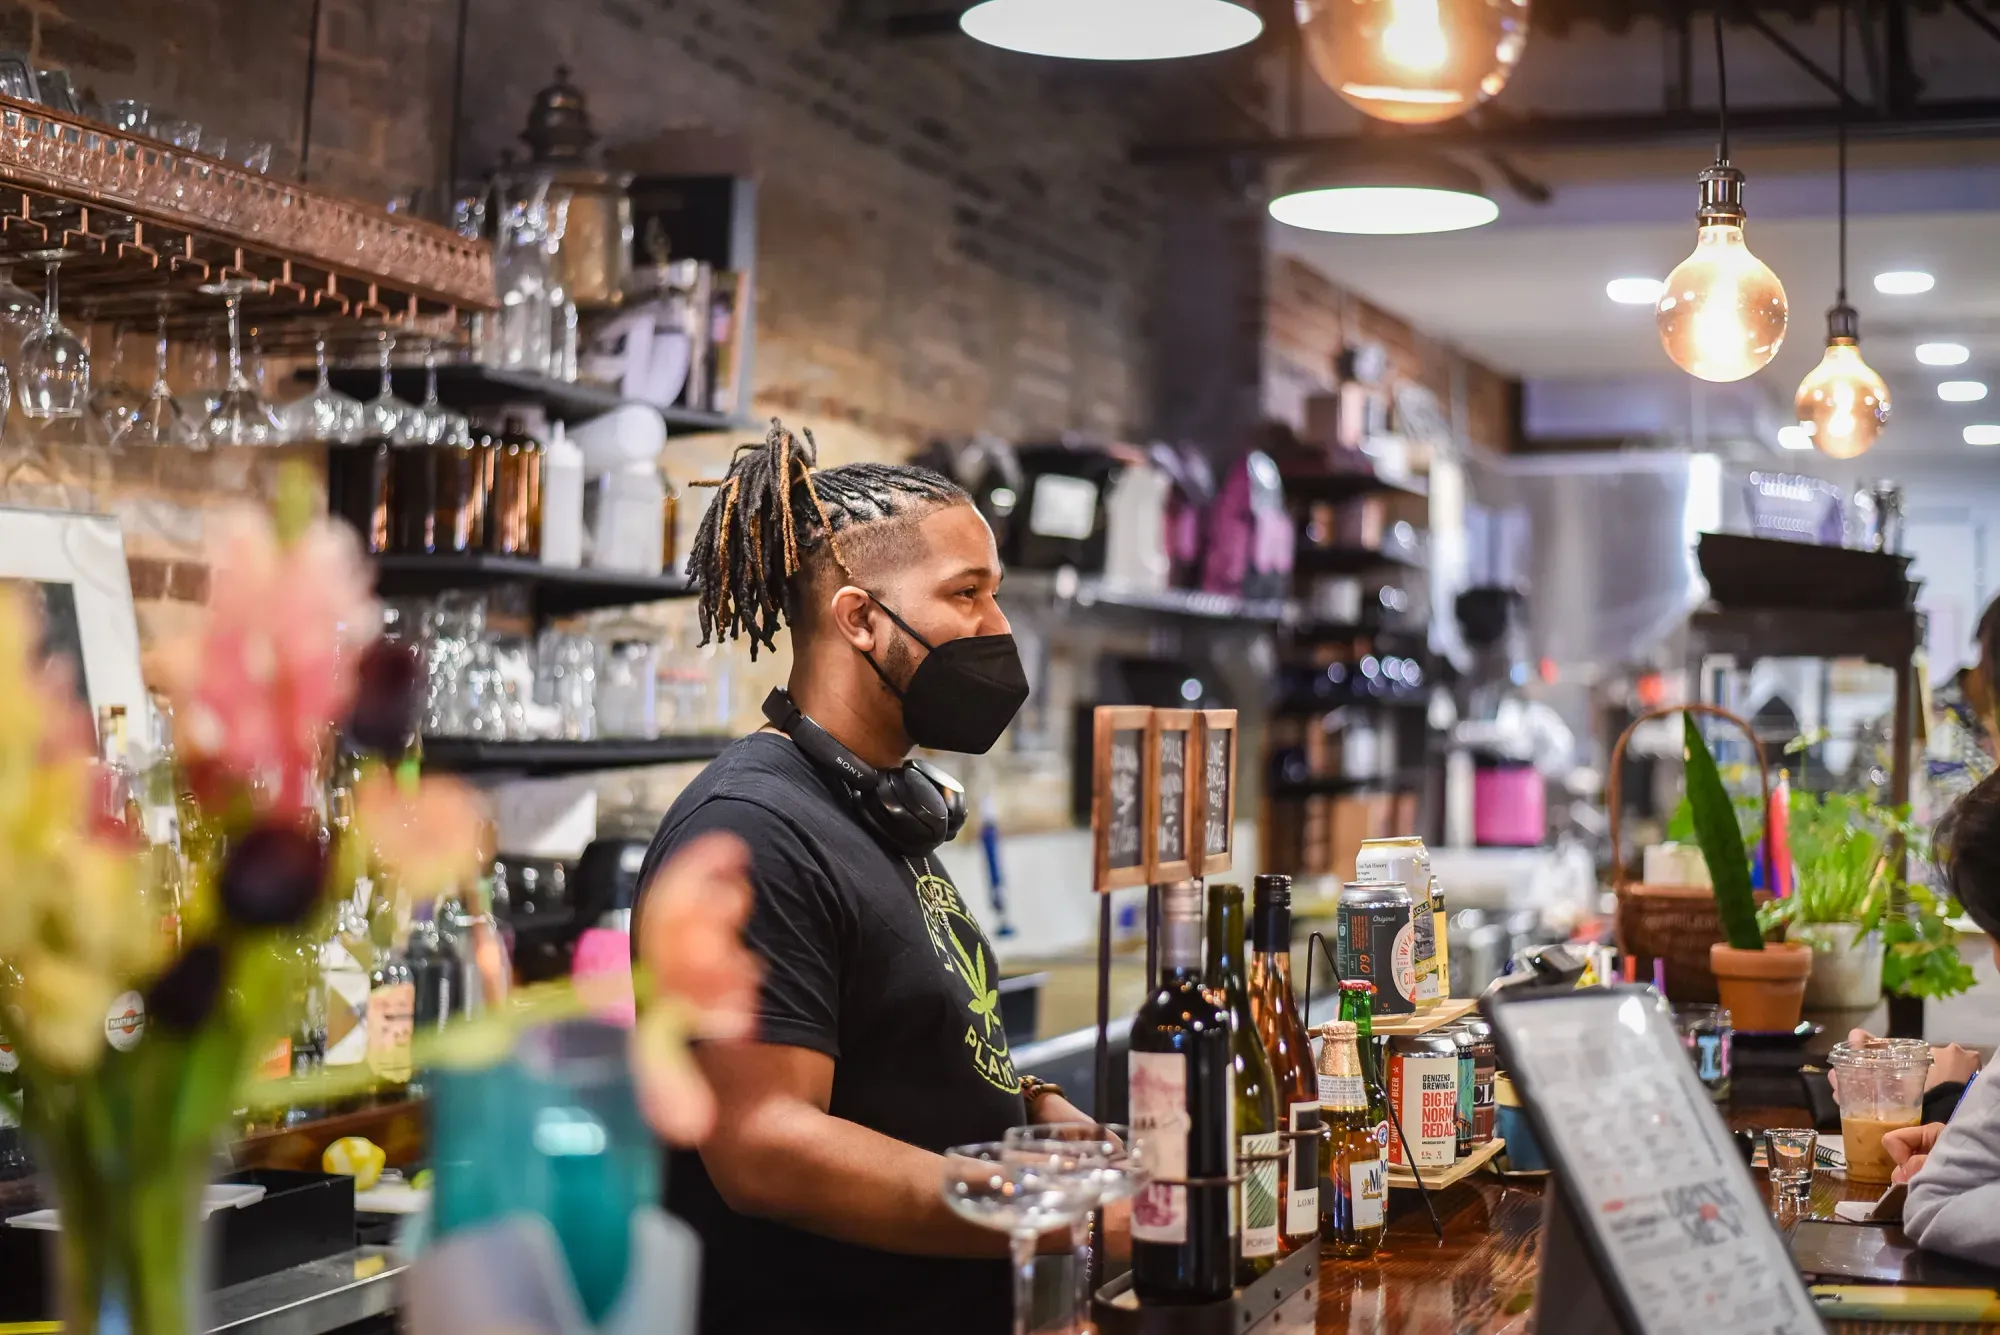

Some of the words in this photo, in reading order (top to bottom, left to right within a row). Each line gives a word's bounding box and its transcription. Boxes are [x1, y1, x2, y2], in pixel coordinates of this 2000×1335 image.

[836, 756, 864, 778] SONY
[1422, 1074, 1450, 1082] DENIZENS
[1422, 1082, 1449, 1090] BREWING
[1392, 1099, 1399, 1110] BY
[1422, 1092, 1441, 1107] BIG
[1443, 1091, 1457, 1106] RED
[1422, 1122, 1444, 1138] RED
